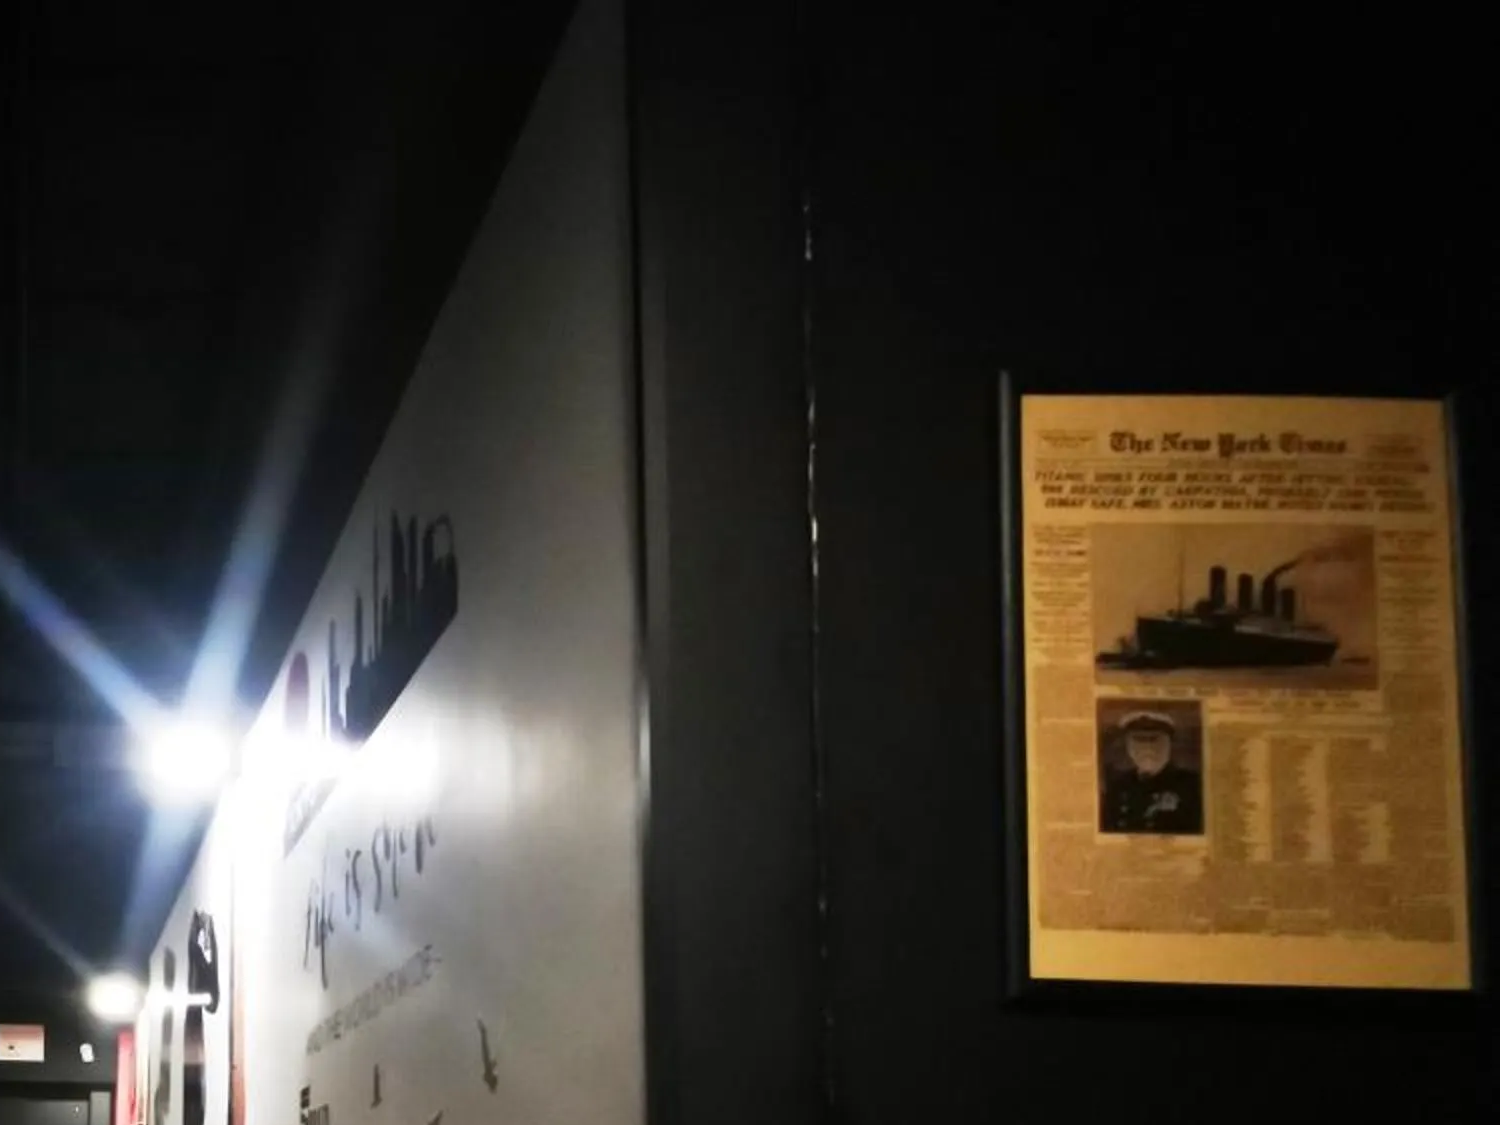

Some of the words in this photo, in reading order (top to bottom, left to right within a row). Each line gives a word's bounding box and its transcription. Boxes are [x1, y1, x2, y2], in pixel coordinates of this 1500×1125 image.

[1109, 430, 1155, 455] The
[1160, 431, 1212, 453] New
[1218, 431, 1271, 460] York
[1278, 431, 1350, 455] Times
